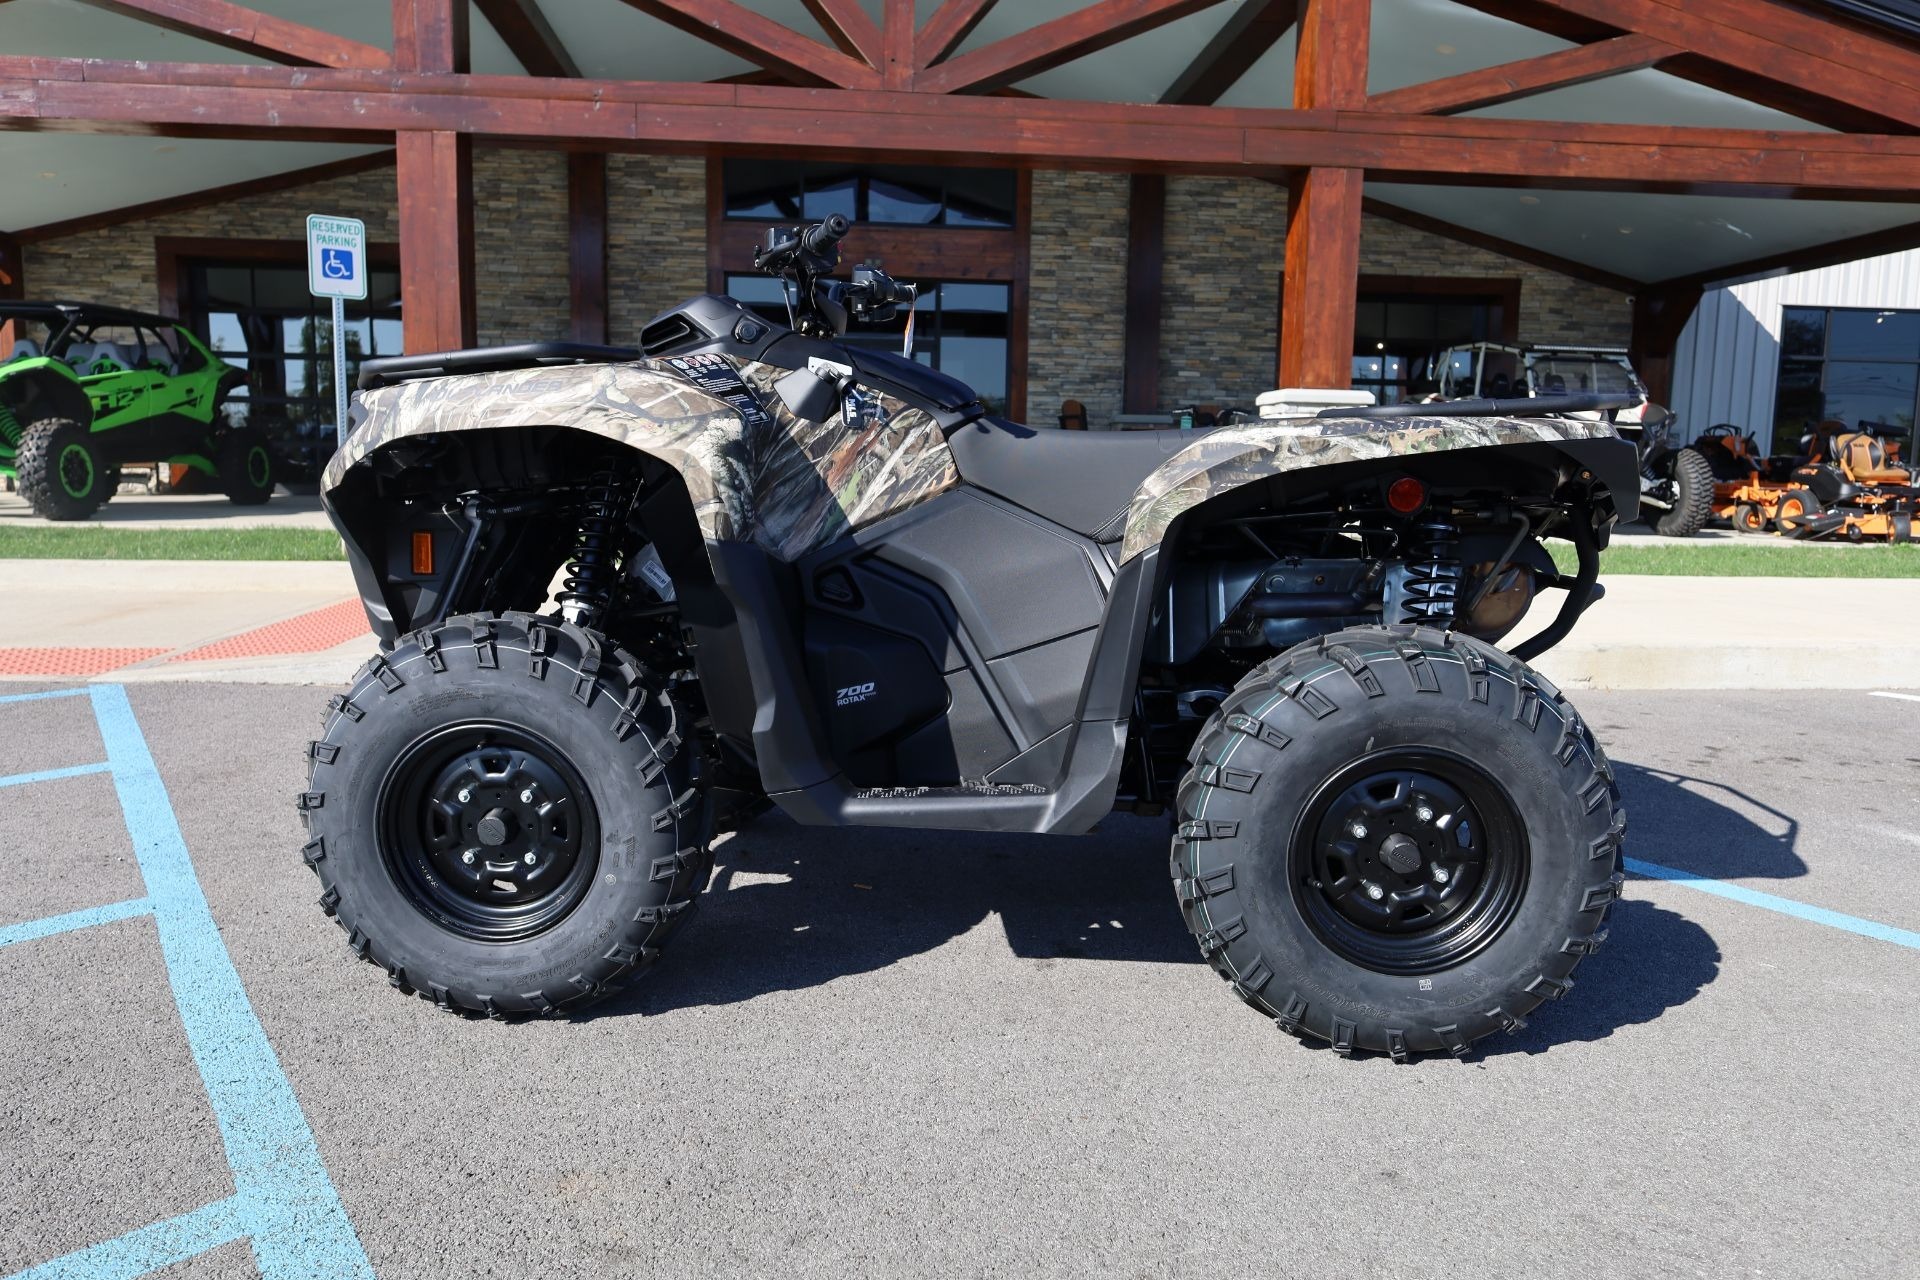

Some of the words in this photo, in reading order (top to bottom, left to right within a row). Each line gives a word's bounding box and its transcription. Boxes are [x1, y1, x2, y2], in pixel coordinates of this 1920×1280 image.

[312, 221, 360, 236] RESERVED
[316, 234, 357, 248] PARKING
[837, 682, 875, 699] 700
[837, 694, 866, 706] ROTAX
